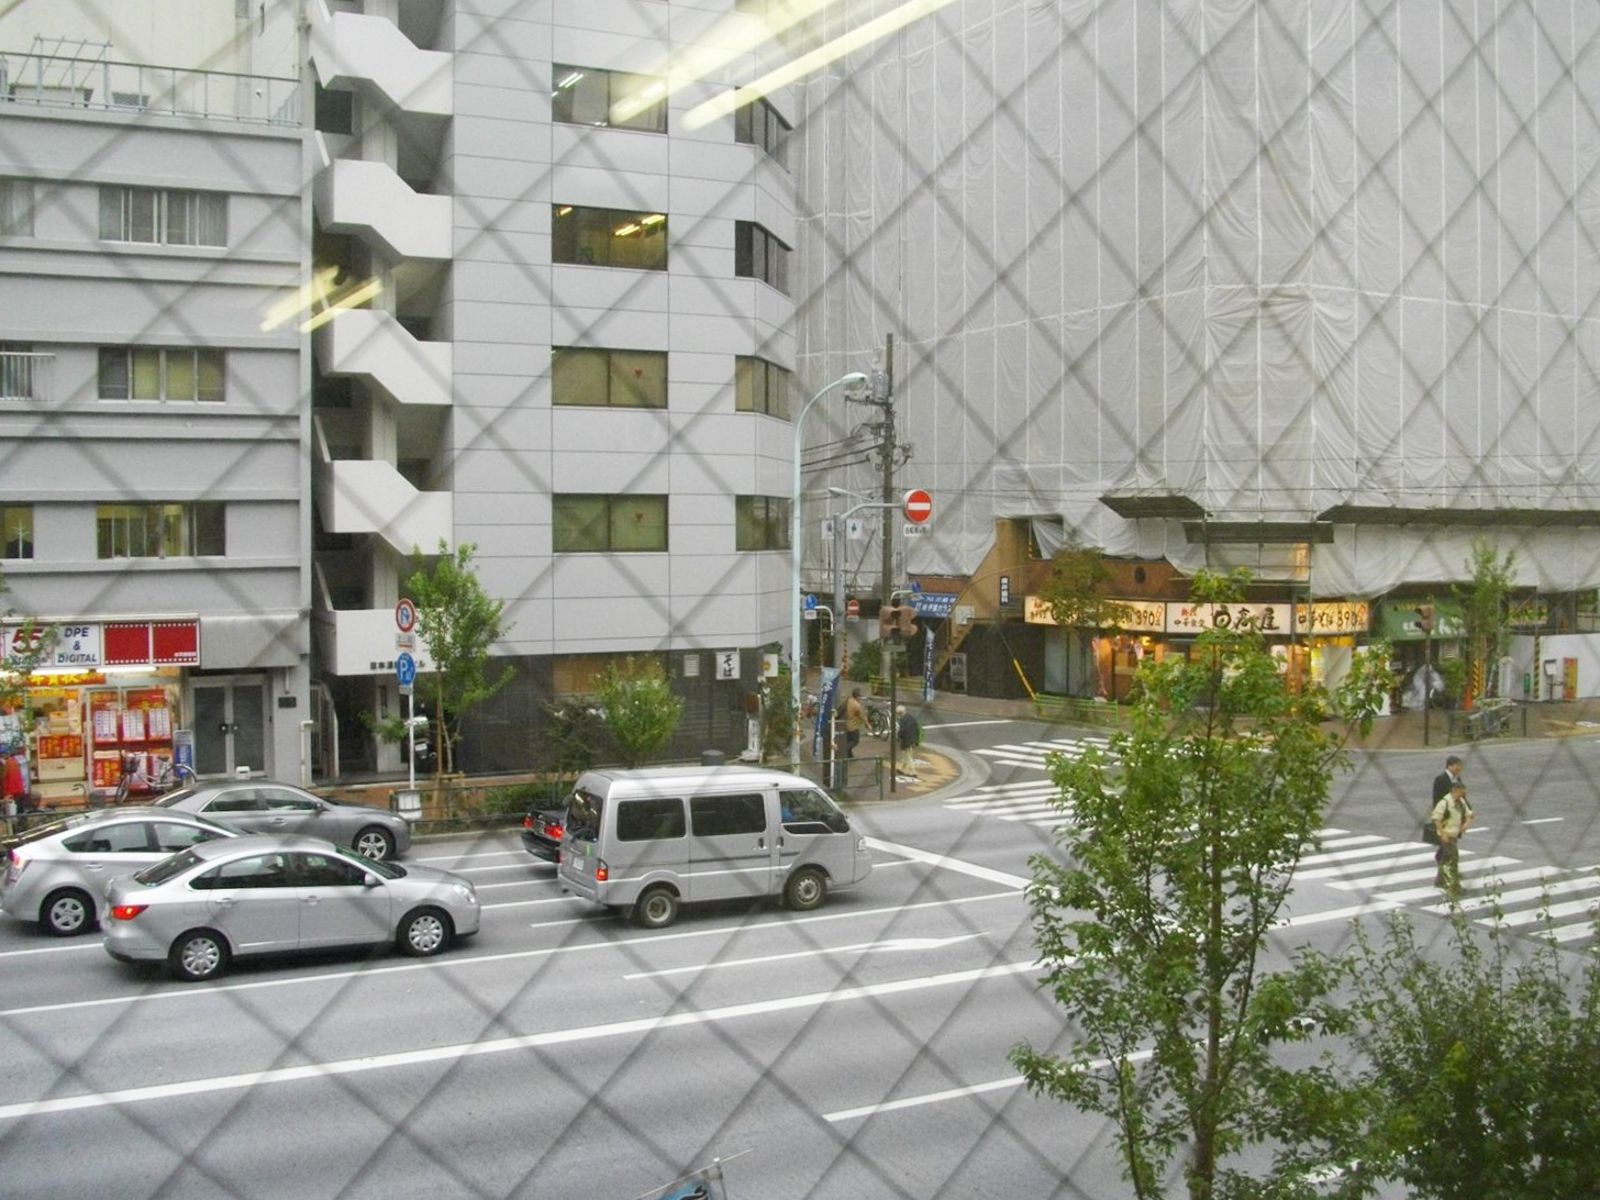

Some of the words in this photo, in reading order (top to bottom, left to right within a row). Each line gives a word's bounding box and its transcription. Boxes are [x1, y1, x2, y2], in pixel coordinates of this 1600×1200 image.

[64, 627, 90, 638] DPE
[73, 640, 81, 651] &
[57, 653, 97, 663] DIGITAL
[723, 654, 735, 677] そば
